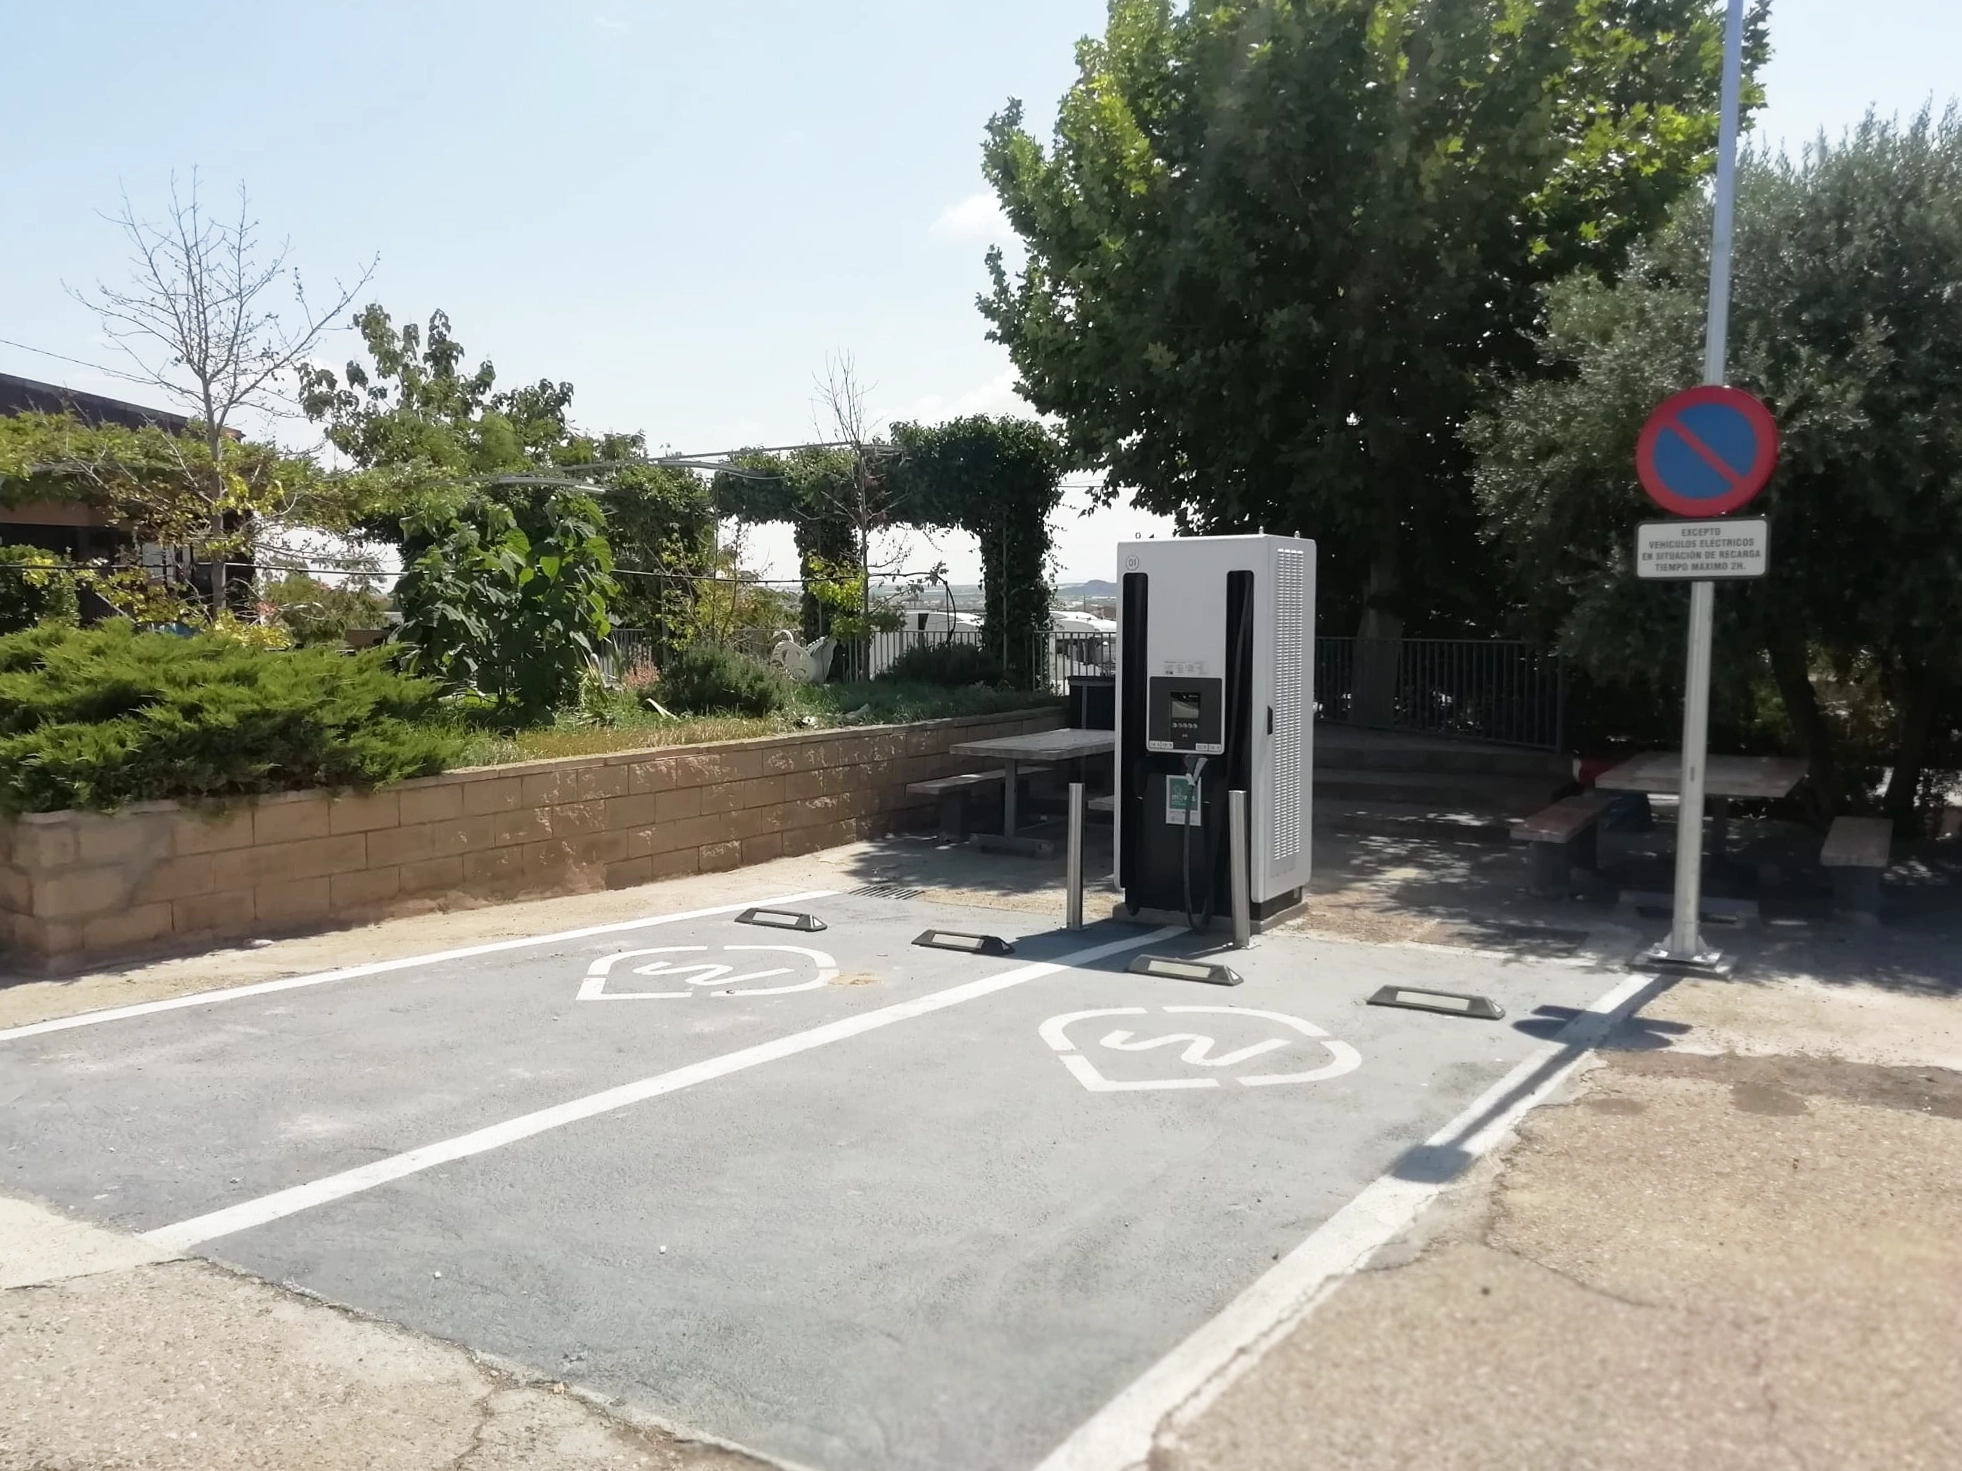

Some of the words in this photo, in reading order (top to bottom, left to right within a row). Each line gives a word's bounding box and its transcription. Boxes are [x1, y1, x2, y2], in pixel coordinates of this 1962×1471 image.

[1681, 528, 1721, 537] EXCEPTO
[1642, 552, 1653, 561] EN
[1704, 551, 1716, 559] DE
[1719, 550, 1761, 559] RECARGA
[1655, 563, 1688, 571] TIEMPO
